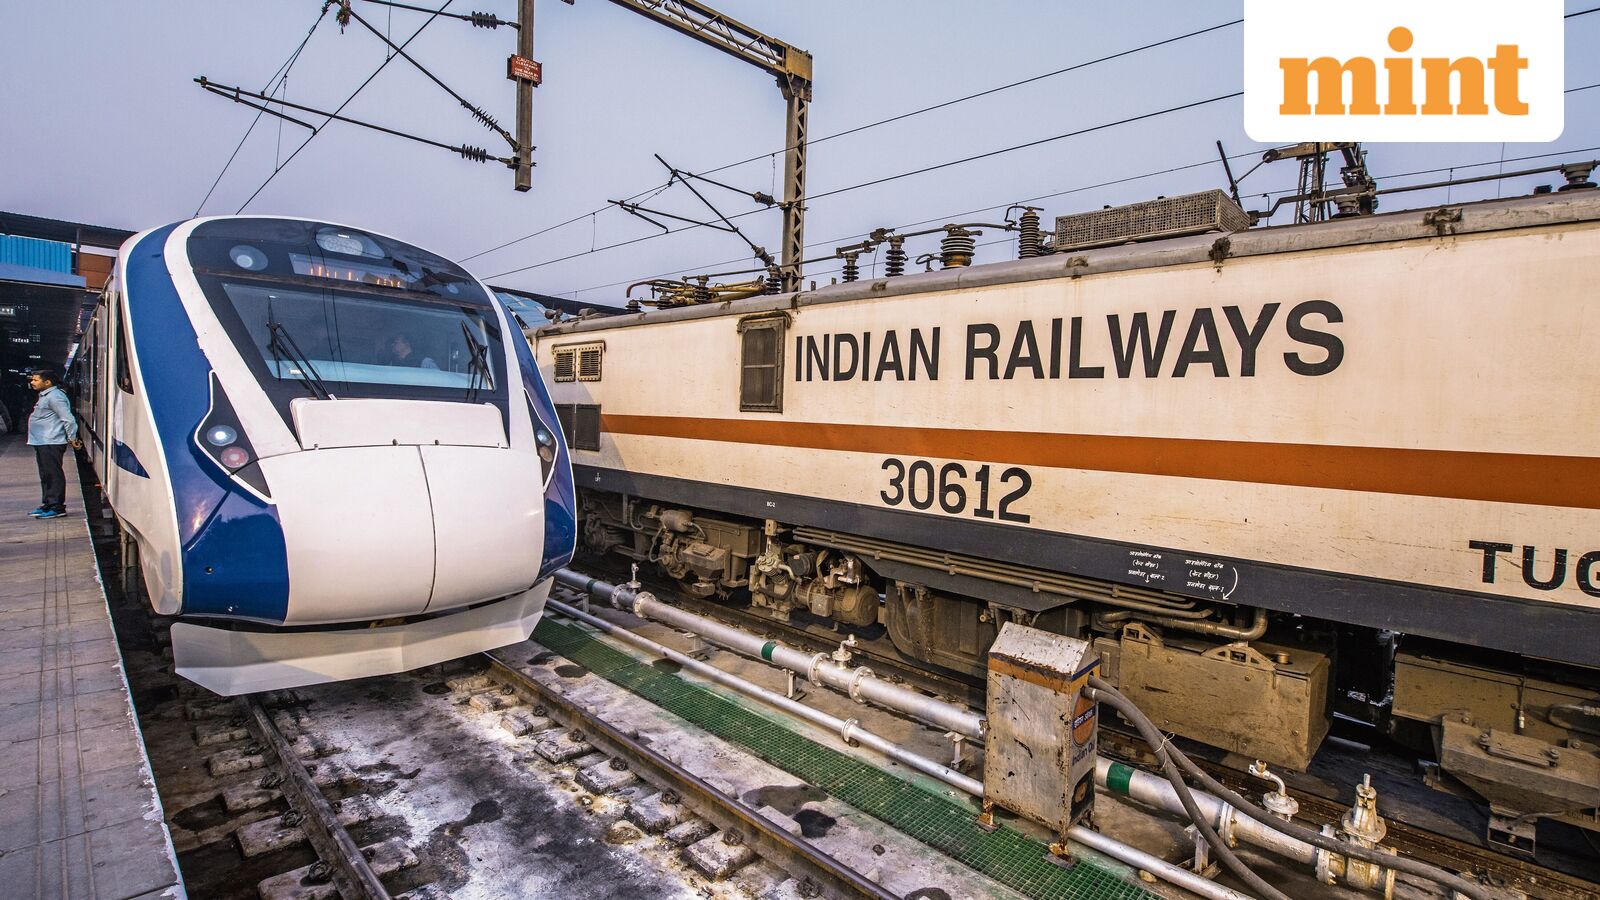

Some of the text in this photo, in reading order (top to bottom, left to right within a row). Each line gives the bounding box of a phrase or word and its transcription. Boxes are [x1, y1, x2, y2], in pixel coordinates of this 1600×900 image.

[795, 299, 1345, 382] INDIAN RAILWAYS
[880, 457, 1032, 524] 30612
[1468, 539, 1600, 598] TUG
